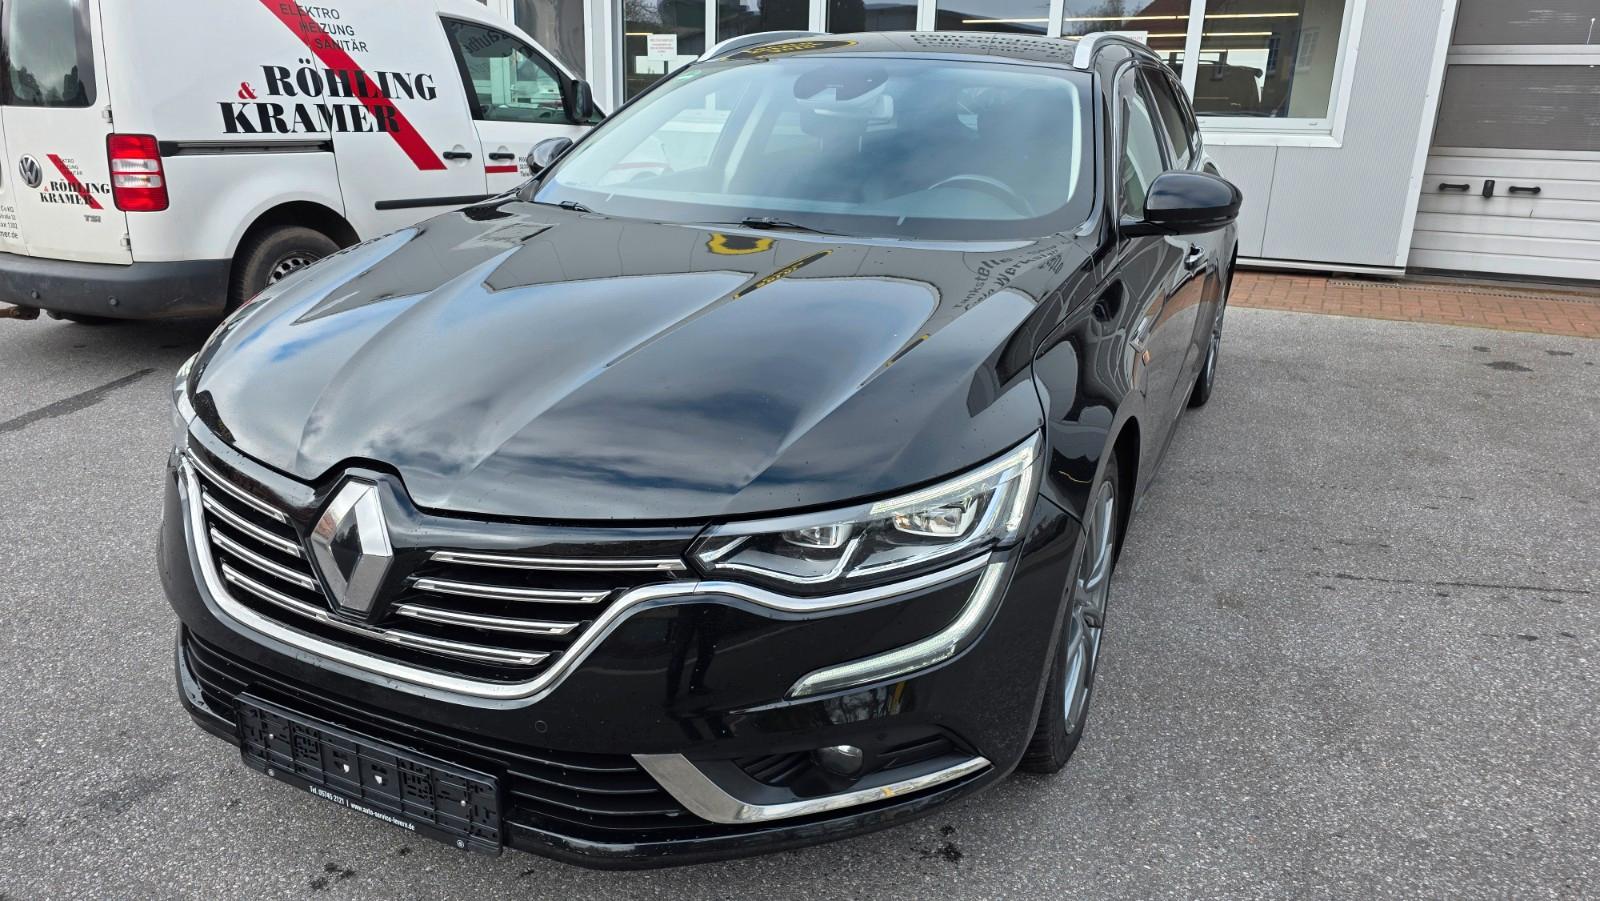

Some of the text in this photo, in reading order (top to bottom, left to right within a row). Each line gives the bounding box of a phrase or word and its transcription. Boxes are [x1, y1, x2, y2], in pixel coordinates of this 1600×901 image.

[279, 3, 340, 20] ELEKTRO
[299, 22, 355, 36] HEIZUNG
[314, 38, 369, 53] SANITÄR
[237, 57, 438, 101] & RÖHLING
[216, 101, 401, 135] KRAMER
[50, 178, 110, 194] RÖHLING
[40, 192, 94, 206] KRAMER
